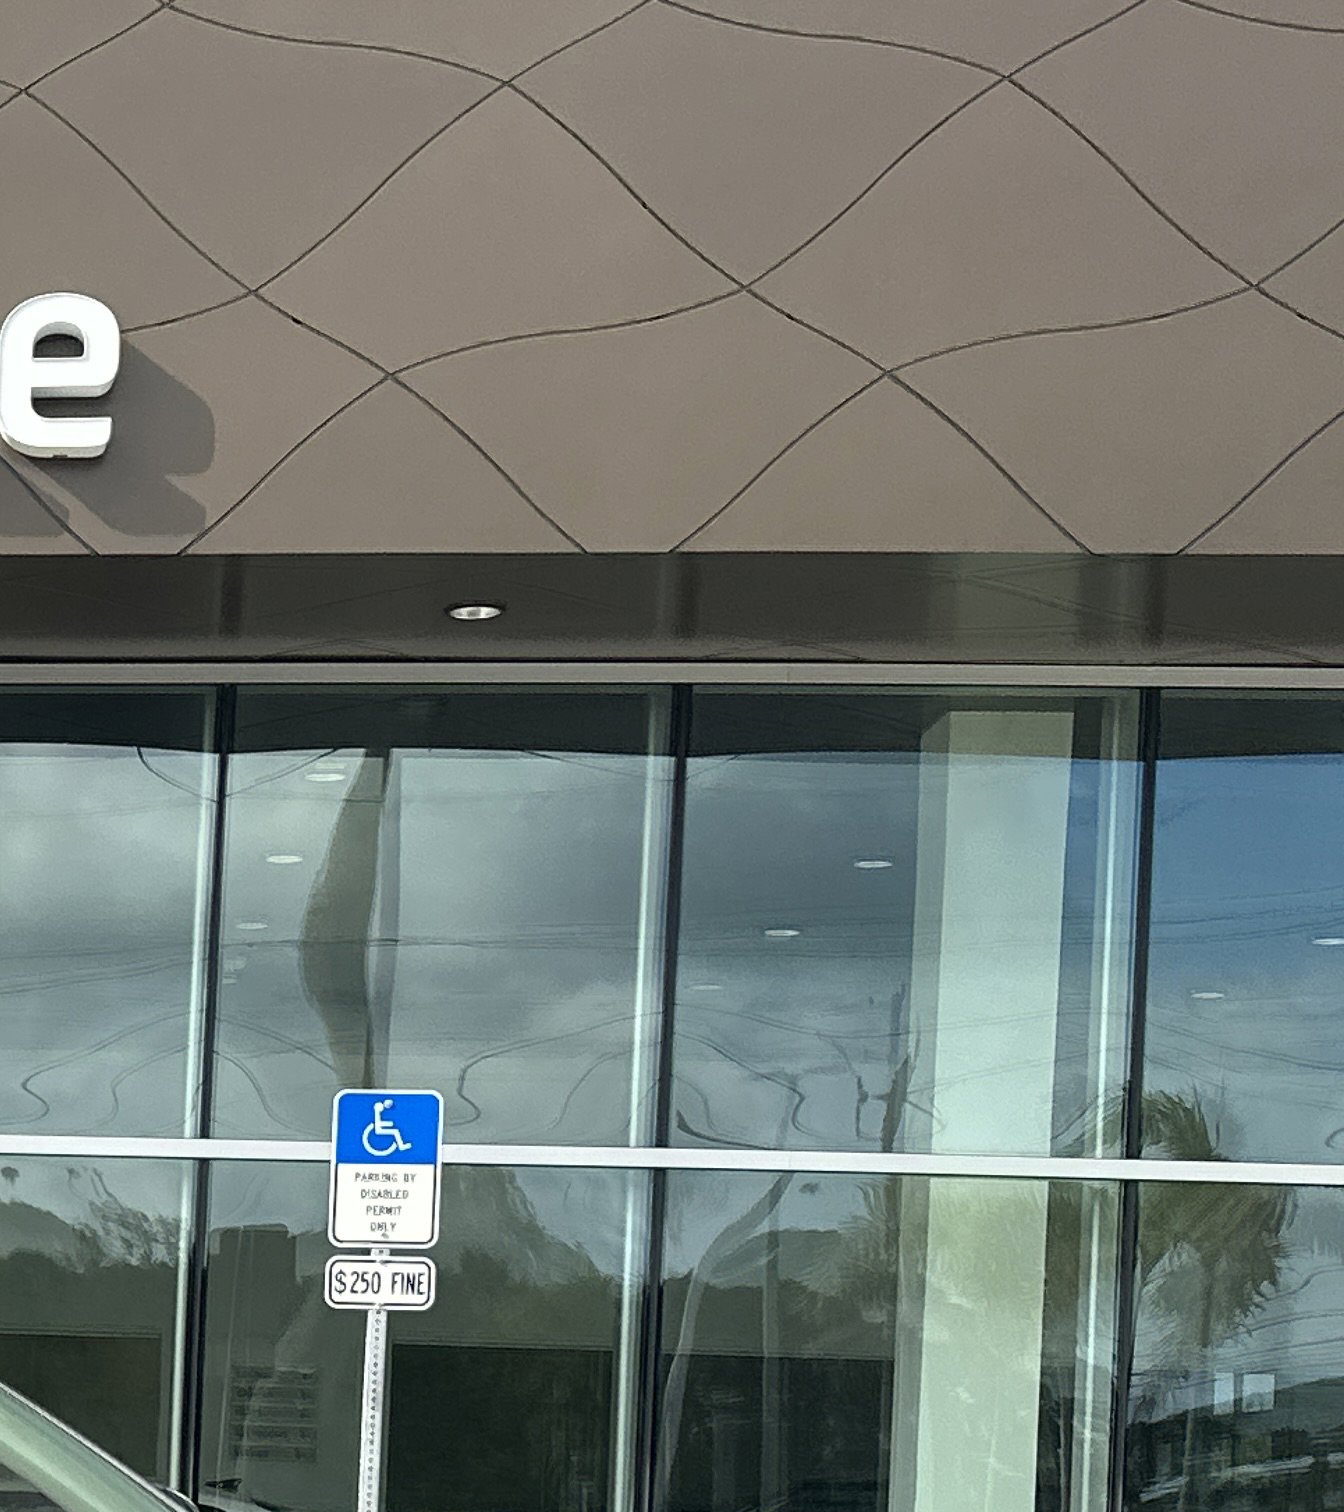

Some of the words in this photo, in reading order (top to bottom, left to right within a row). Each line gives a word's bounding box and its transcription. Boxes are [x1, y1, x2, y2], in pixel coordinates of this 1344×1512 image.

[354, 1172, 399, 1183] PARKING
[403, 1173, 417, 1183] BY
[360, 1189, 409, 1200] DISABLED
[366, 1206, 402, 1216] PERMIT
[370, 1222, 397, 1233] ONLY
[334, 1269, 382, 1296] $250
[391, 1271, 426, 1296] FINE
